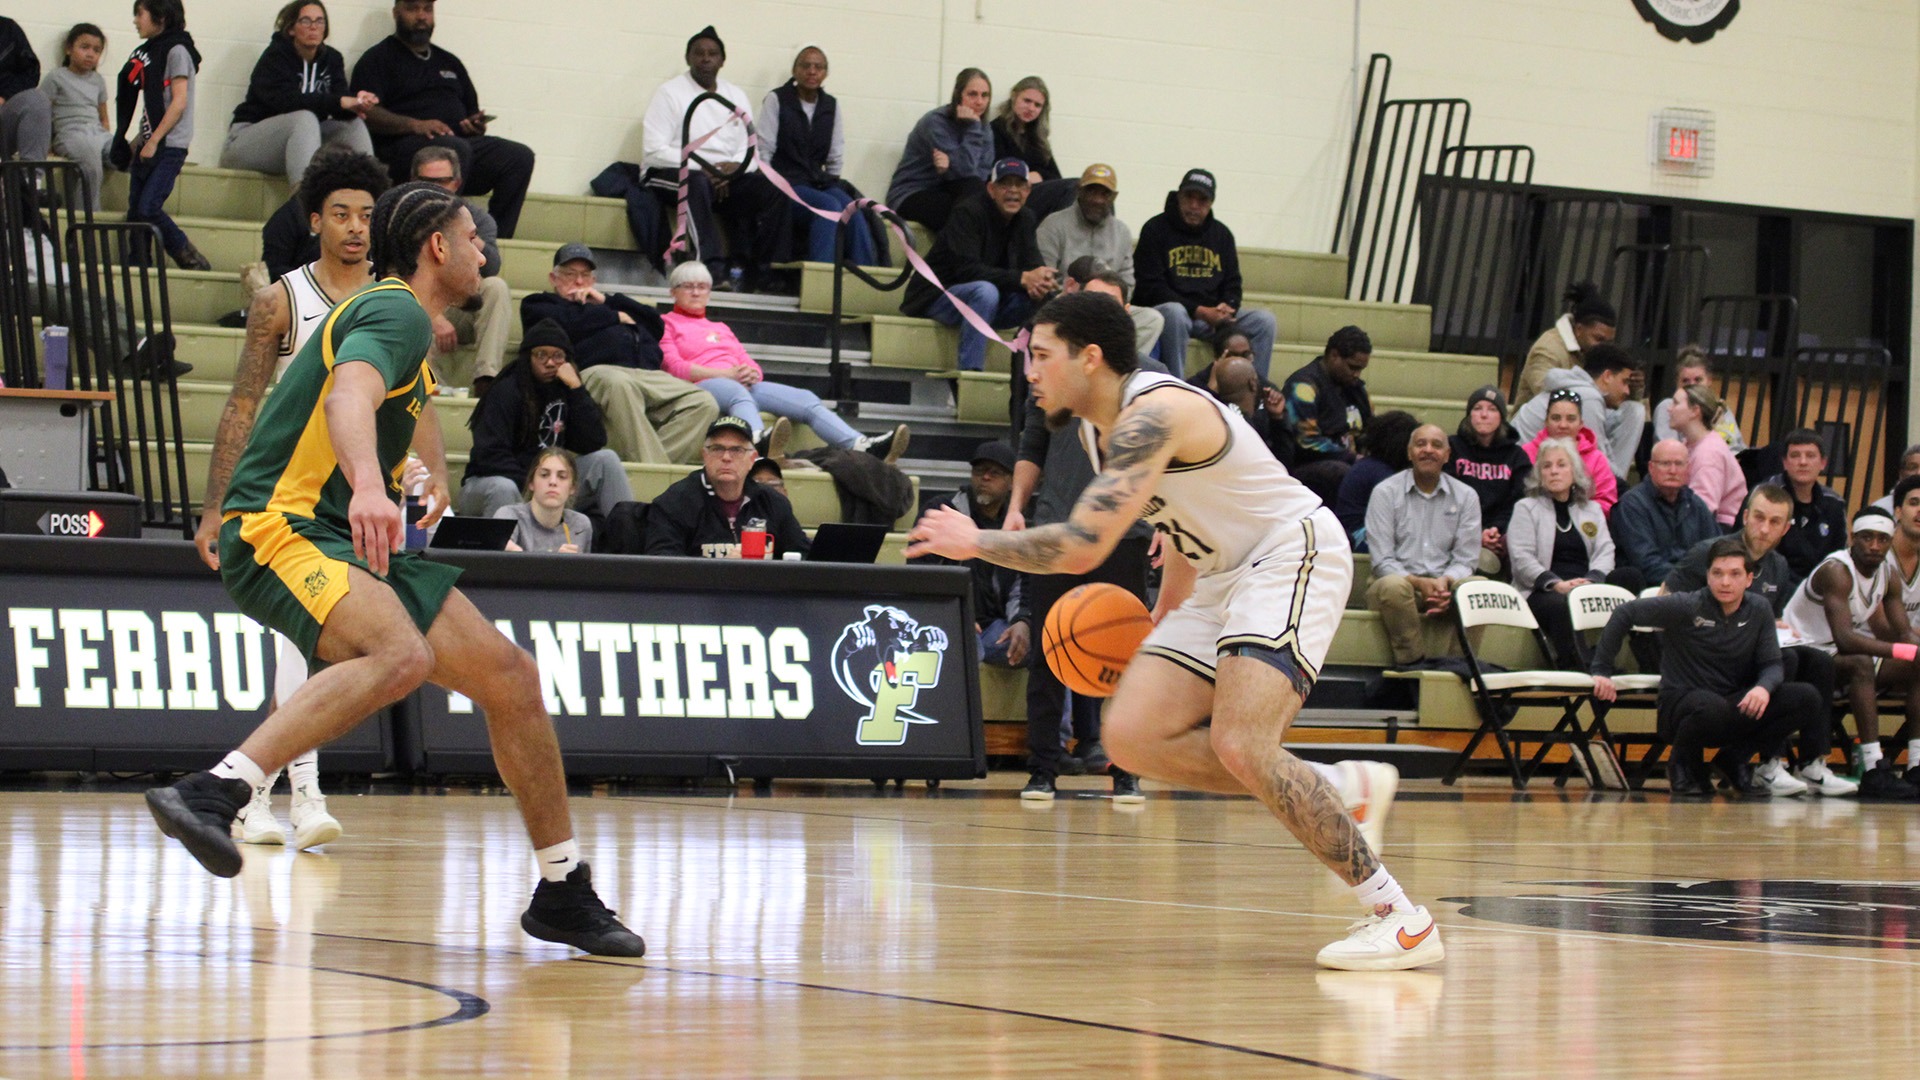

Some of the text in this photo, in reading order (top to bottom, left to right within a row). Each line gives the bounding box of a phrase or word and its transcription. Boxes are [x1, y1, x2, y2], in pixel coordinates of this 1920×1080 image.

[1669, 127, 1699, 159] EXIT
[1168, 245, 1222, 272] FERRUM
[50, 513, 89, 535] POSS
[1467, 593, 1521, 611] FERRUM
[1580, 597, 1627, 613] FERRU
[7, 607, 284, 711] FERRU
[447, 619, 815, 720] NTHERS
